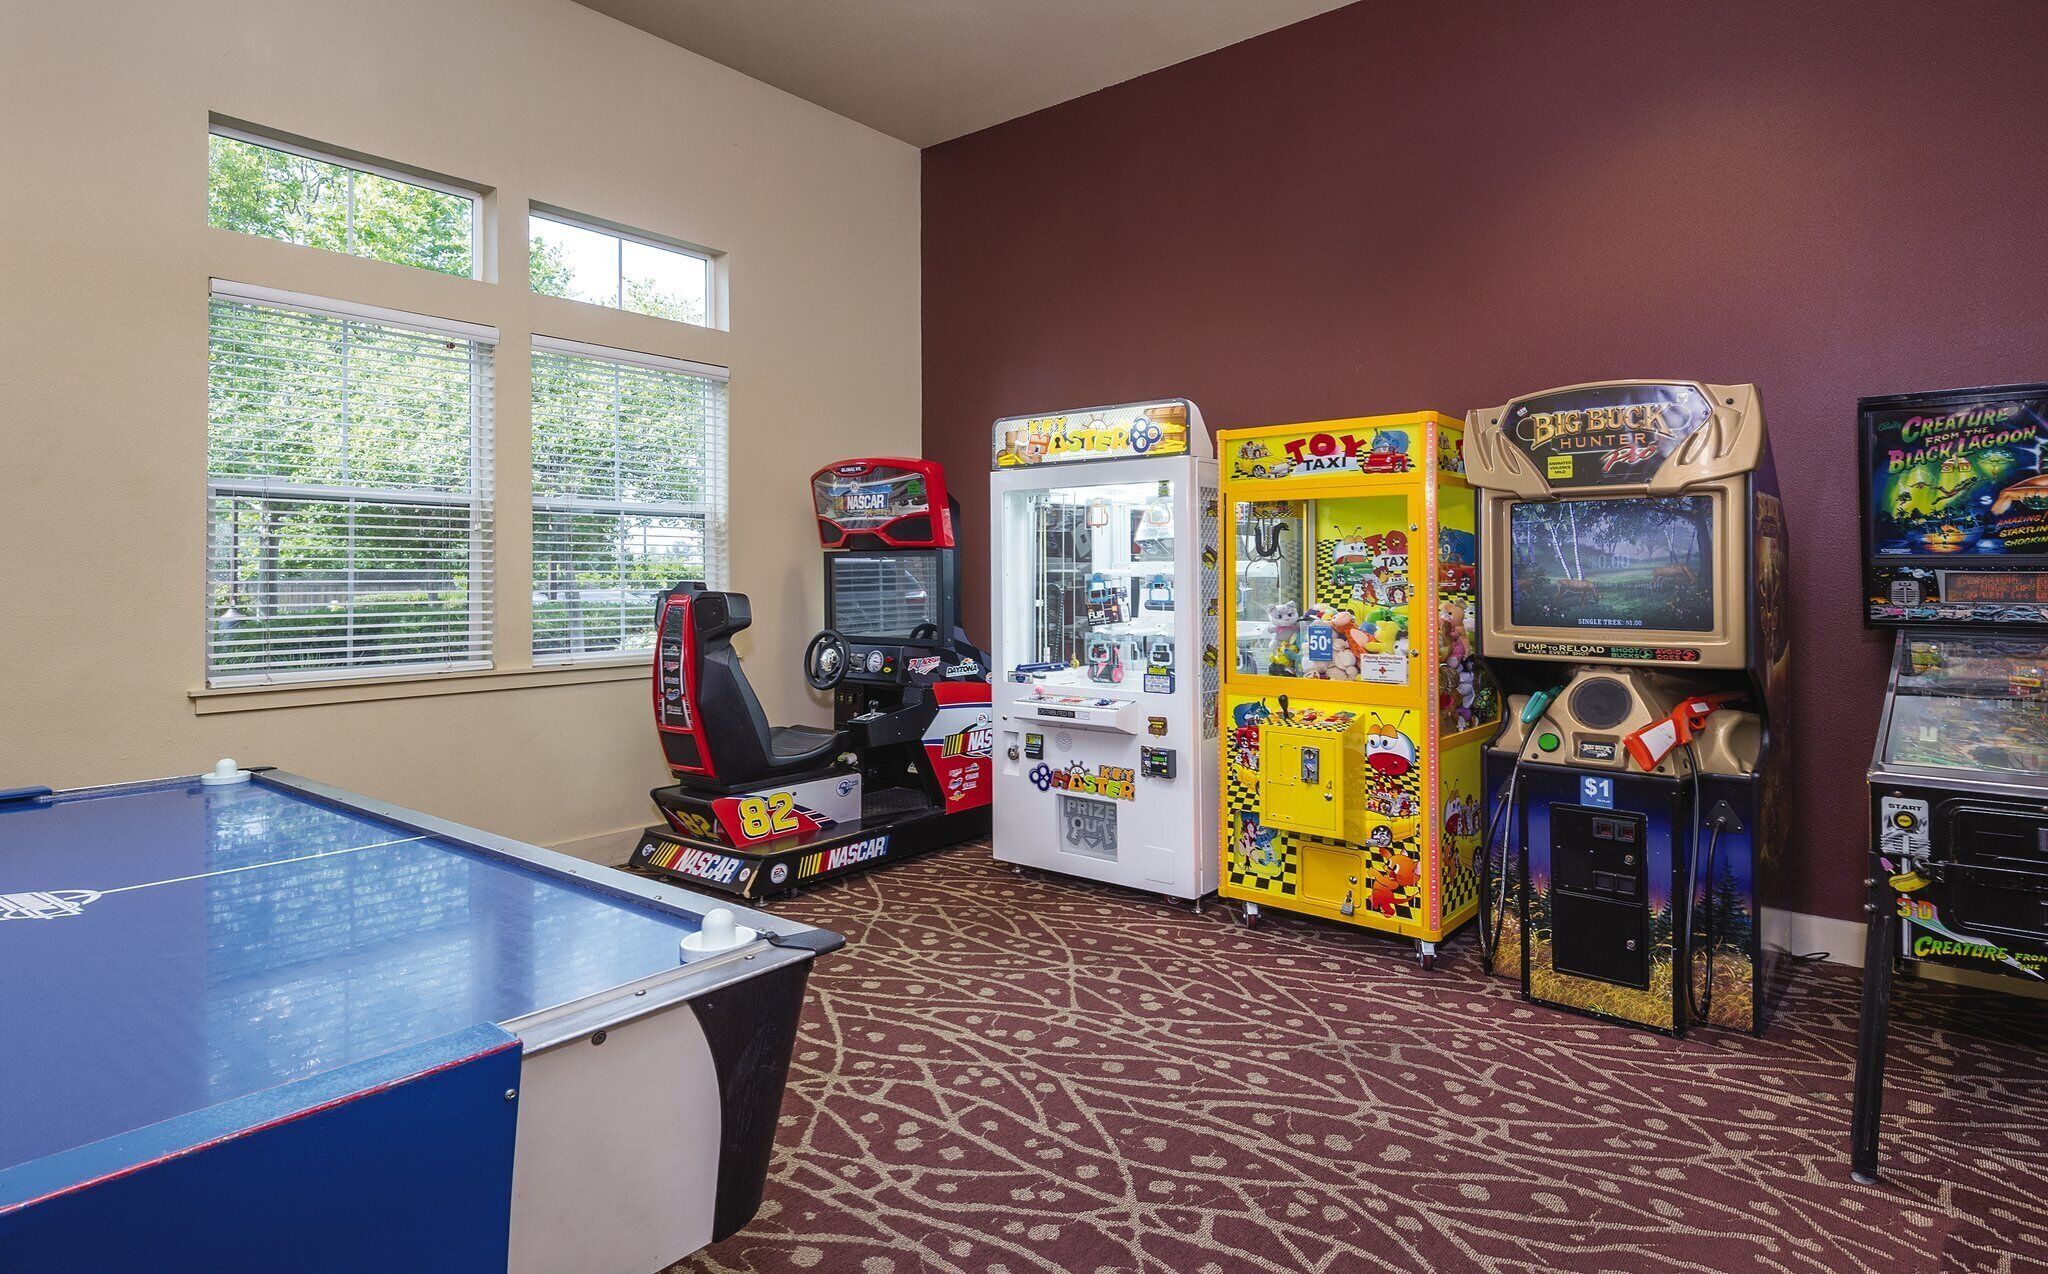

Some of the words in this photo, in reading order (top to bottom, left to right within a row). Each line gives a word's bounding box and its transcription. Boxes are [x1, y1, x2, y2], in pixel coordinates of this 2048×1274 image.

[1028, 416, 1067, 434] KEY
[1530, 409, 1582, 450] BIG
[1586, 403, 1675, 438] BUCK
[1901, 407, 2010, 443] CREATURE
[1925, 431, 1959, 447] FROM
[1964, 426, 1988, 437] THE
[1027, 427, 1129, 454] MASTER
[1284, 433, 1366, 465] TOY
[1560, 433, 1646, 449] HUNTER
[1888, 441, 1953, 475] BLACK
[1957, 426, 2037, 457] LAGOON
[1303, 456, 1346, 471] TAXI
[846, 494, 885, 510] NASCAR
[1517, 642, 1547, 650] PUMP
[1559, 645, 1605, 653] RELOAD
[947, 664, 978, 674] DAYTONA
[1100, 765, 1134, 781] KEY
[1051, 770, 1135, 800] MASTER
[1584, 777, 1609, 797] $1
[739, 792, 799, 839] 82
[1067, 799, 1116, 819] PRIZE
[1888, 803, 1922, 811] START
[676, 811, 719, 842] 82
[1070, 816, 1110, 845] OUT
[827, 836, 887, 870] NASCAR
[673, 847, 740, 884] NASCAR
[773, 867, 785, 876] EA
[1914, 936, 2008, 961] CREATURE
[2015, 952, 2048, 962] FROM
